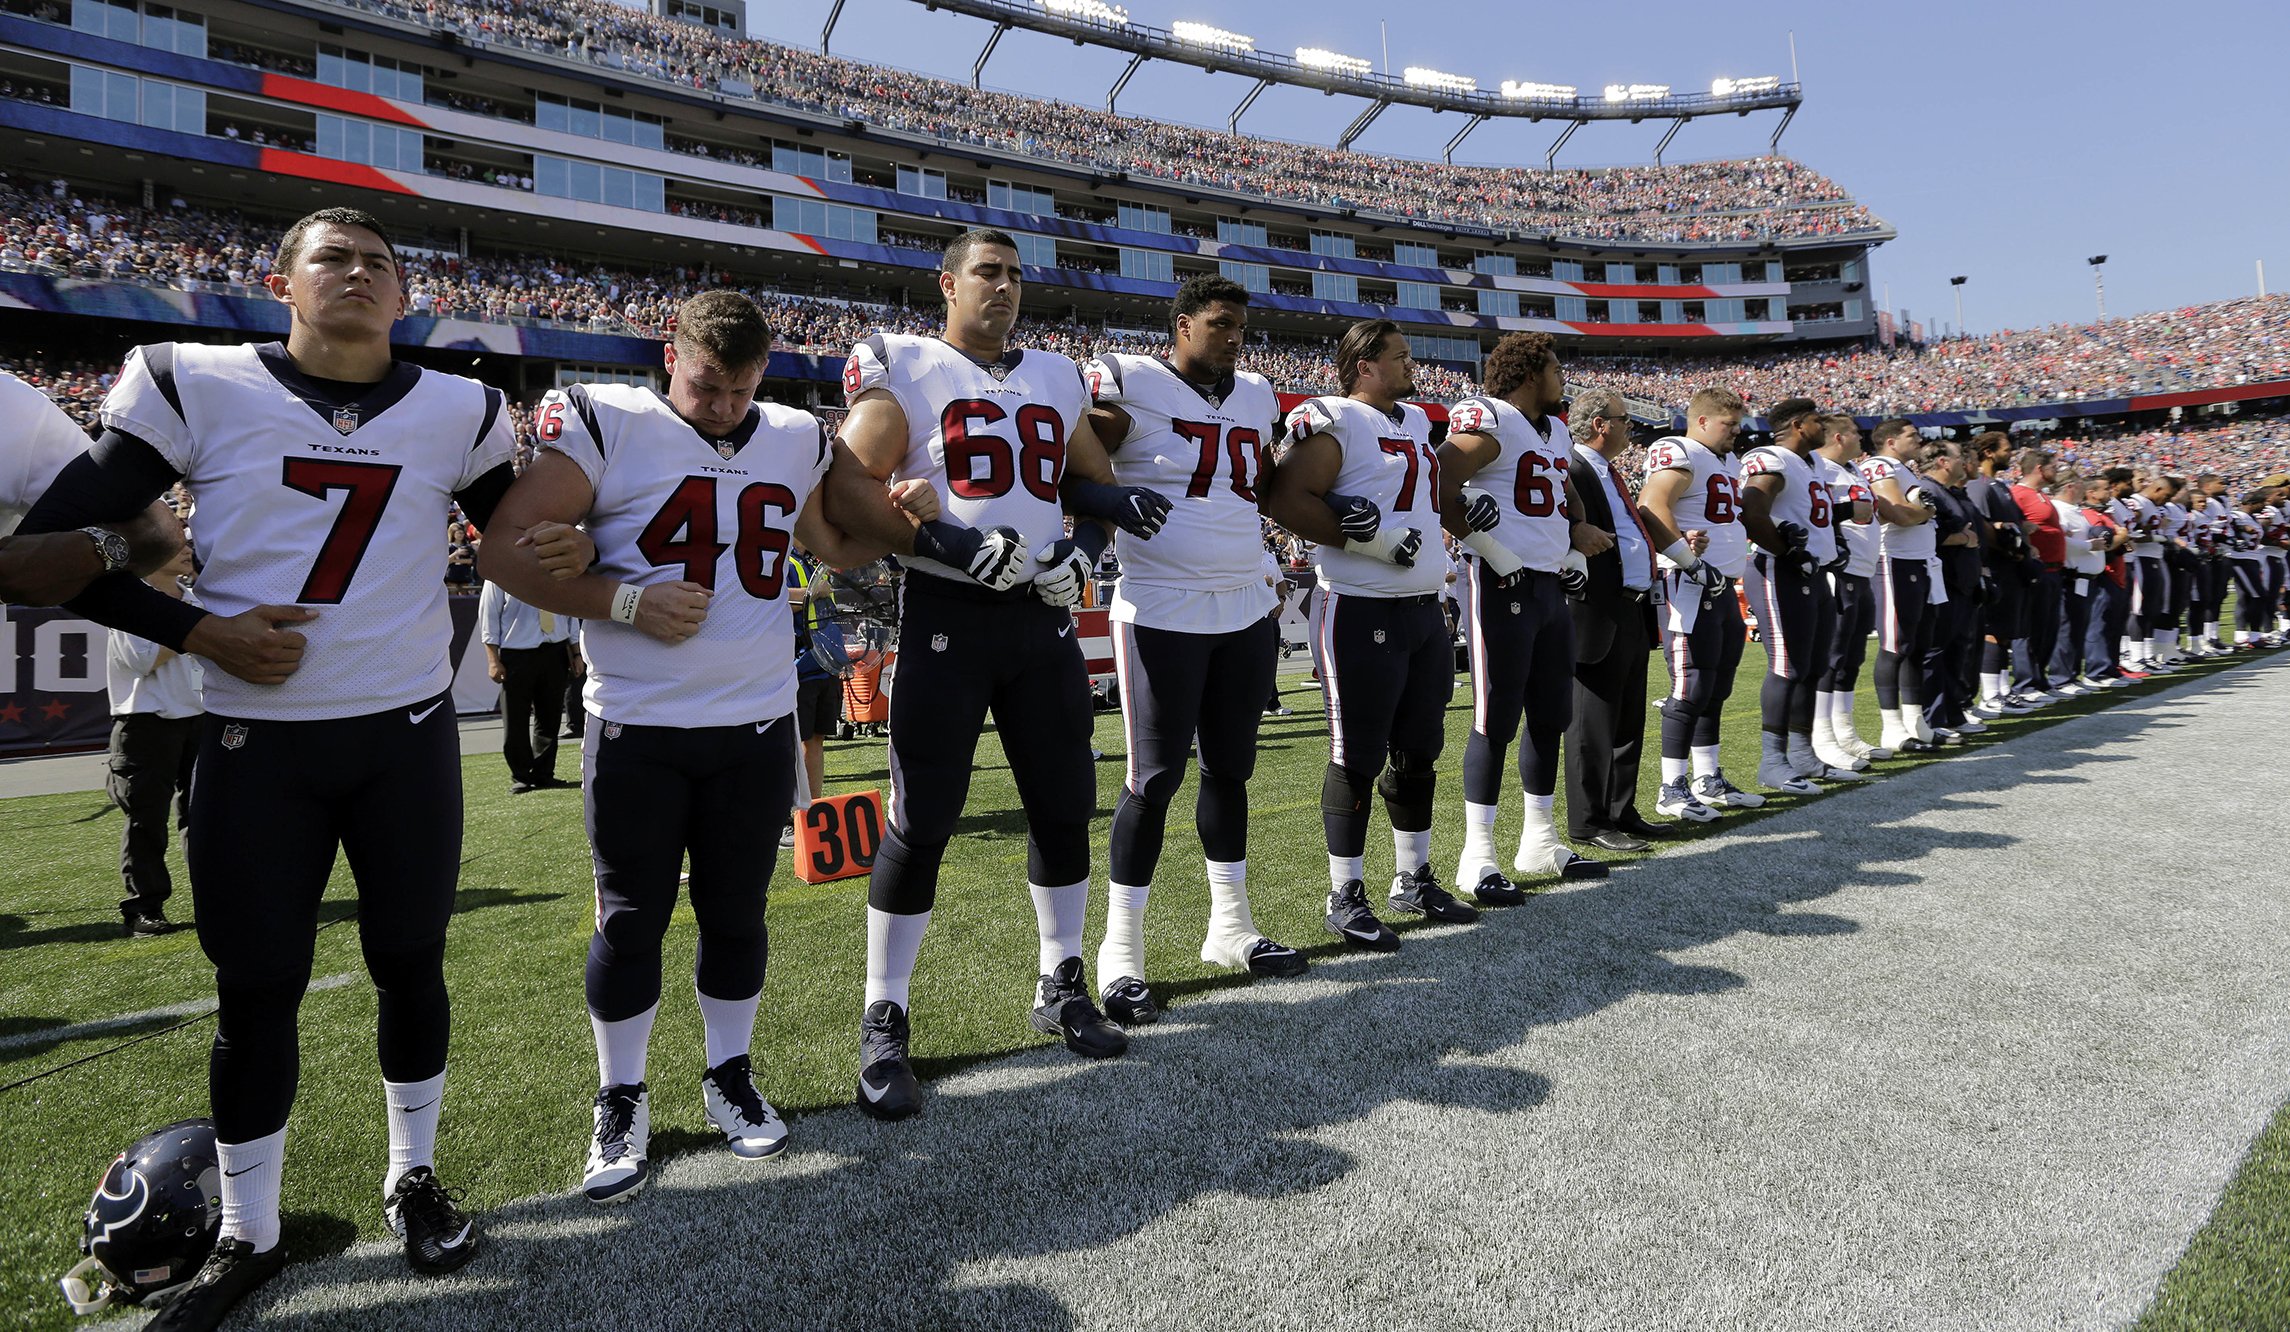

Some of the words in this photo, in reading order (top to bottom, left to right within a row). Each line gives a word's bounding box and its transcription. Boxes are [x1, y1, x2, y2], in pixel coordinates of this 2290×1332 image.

[307, 443, 380, 456] TEXANS
[337, 418, 354, 430] NFL
[941, 398, 1065, 504] 68
[1450, 407, 1482, 432] 63
[1649, 446, 1673, 469] 65
[700, 465, 749, 476] TEXANS
[1171, 417, 1262, 504] 70
[1377, 436, 1441, 514] 71
[282, 456, 403, 604] 7
[635, 475, 797, 600] 46
[806, 795, 881, 875] 30
